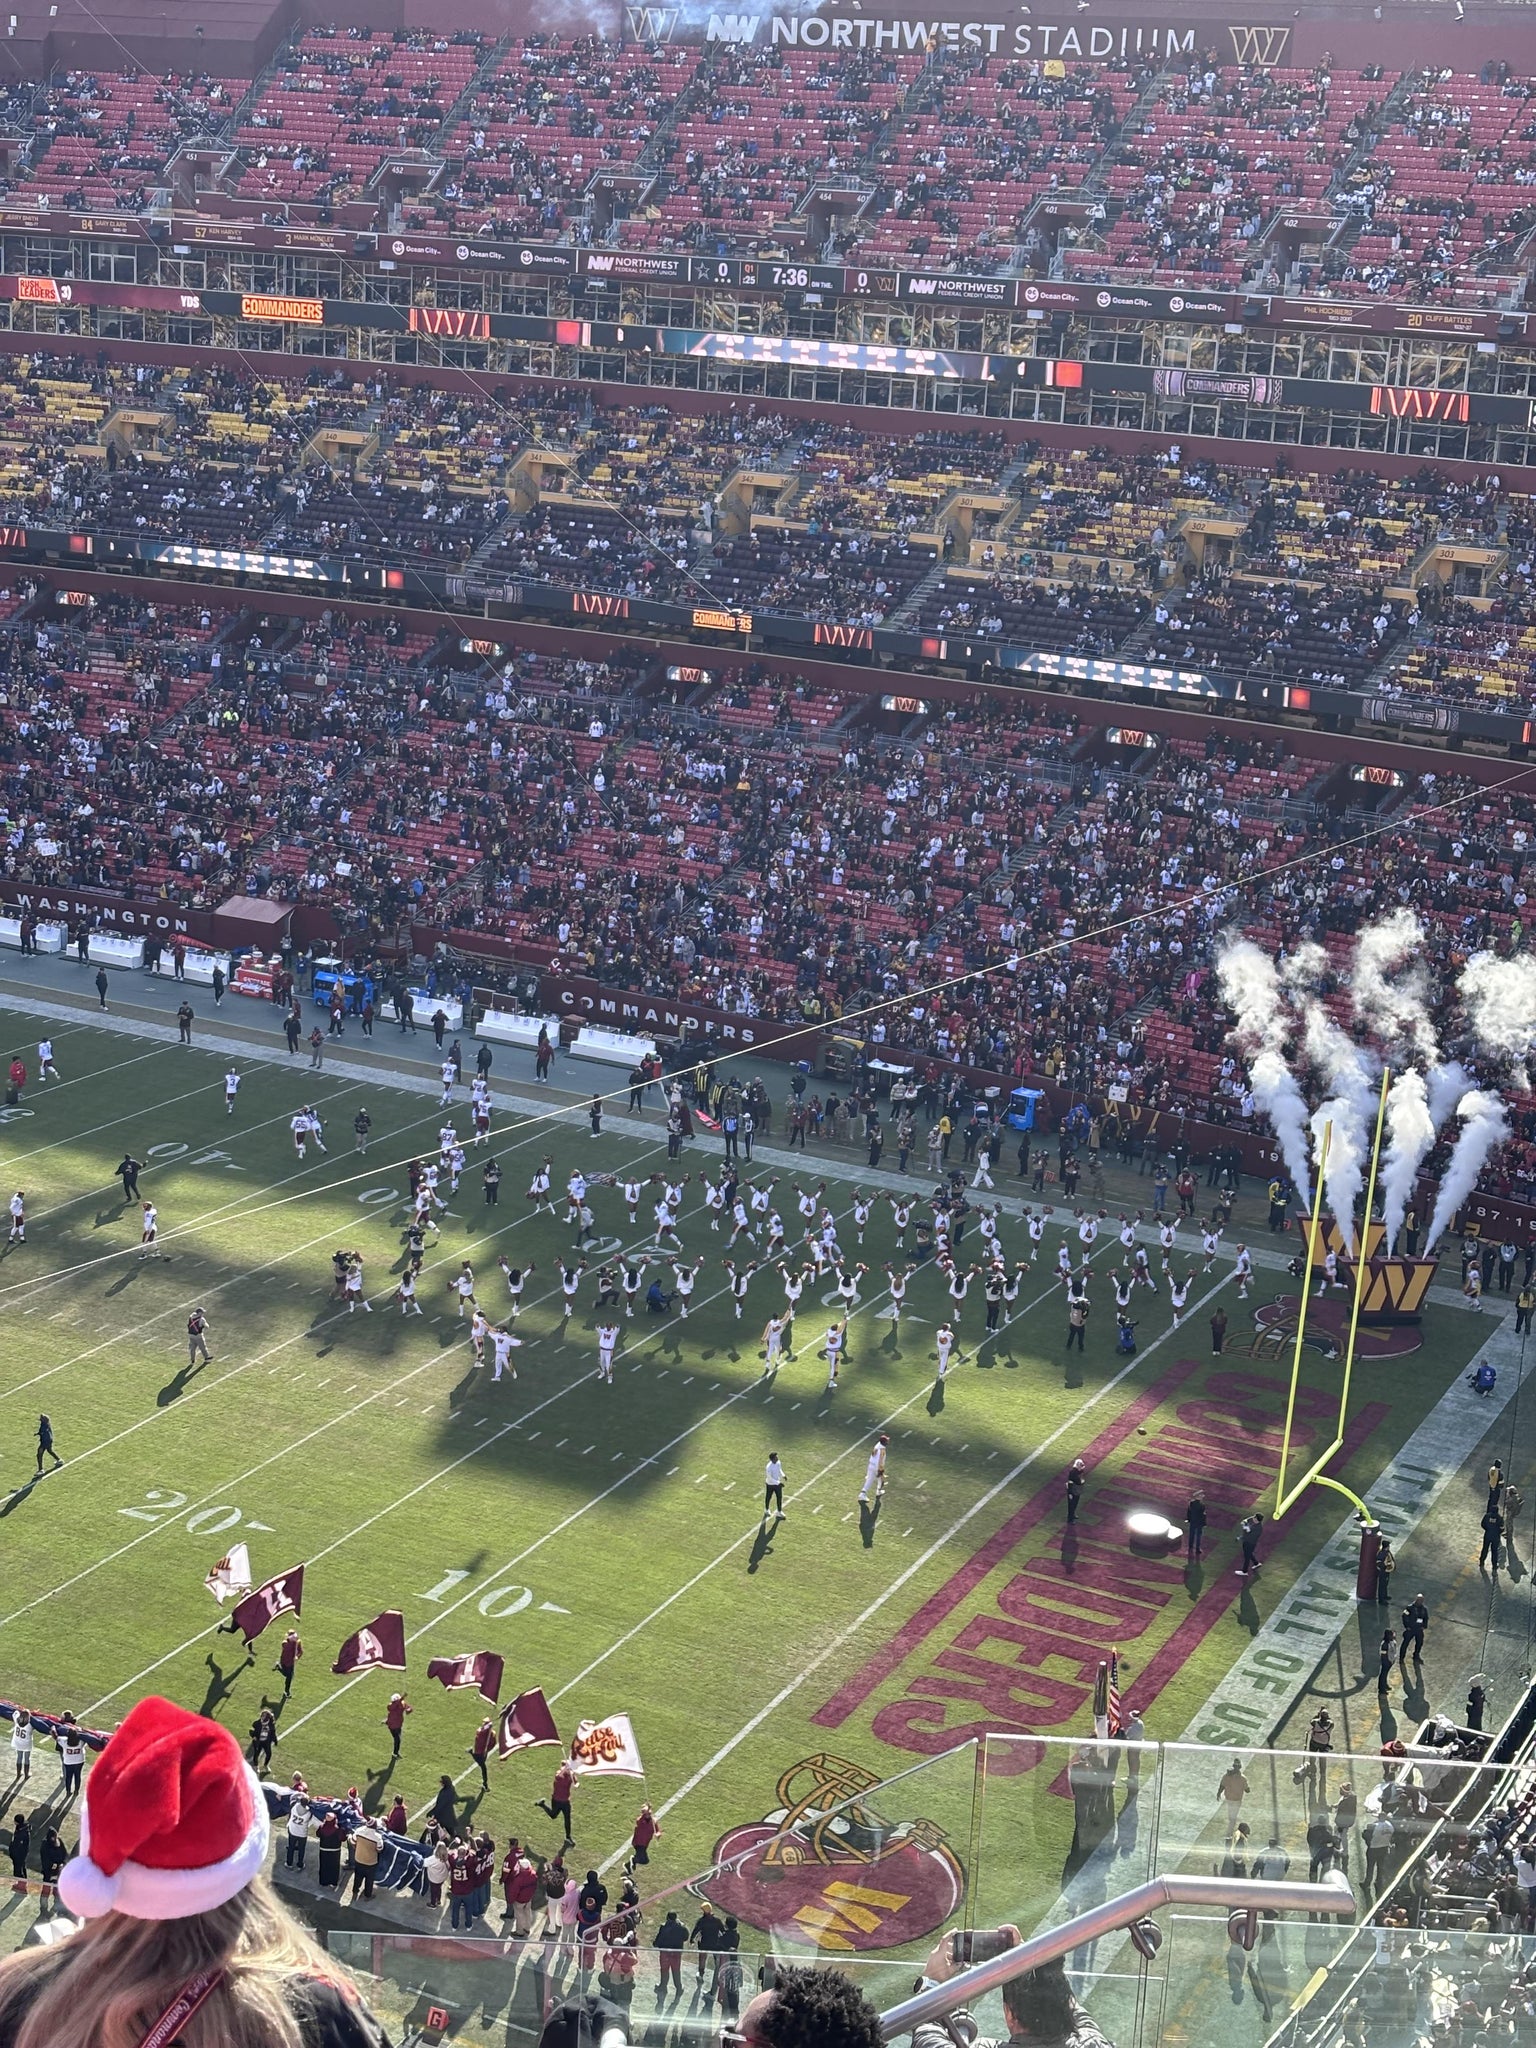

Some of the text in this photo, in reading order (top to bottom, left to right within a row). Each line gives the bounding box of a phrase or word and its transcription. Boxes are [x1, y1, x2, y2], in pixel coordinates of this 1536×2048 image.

[771, 16, 1005, 52] NORTHWEST
[392, 166, 404, 174] 452
[602, 180, 614, 188] 453
[1044, 206, 1058, 215] 401
[81, 219, 93, 230] 84
[1283, 219, 1298, 227] 402
[195, 227, 206, 238] 57
[285, 234, 292, 244] 3
[406, 245, 425, 253] Ocean
[470, 250, 488, 258] Ocean
[534, 255, 552, 263] Ocean
[615, 257, 679, 270] NORTHWEST
[718, 262, 728, 277] 0
[772, 267, 807, 286] 7:36
[858, 272, 868, 287] 0
[20, 279, 40, 289] RUSH
[938, 280, 1006, 294] NORTHWEST
[20, 288, 56, 299] LEADERS
[1040, 292, 1060, 300] Ocean
[180, 295, 200, 308] YDS
[1112, 297, 1133, 305] Ocean
[1185, 302, 1206, 310] Ocean
[242, 298, 323, 320] COMMANDERS
[1408, 314, 1422, 326] 20
[1191, 523, 1206, 531] 302
[1440, 549, 1455, 559] 303
[693, 613, 752, 630] COMMANDRS
[17, 893, 188, 933] WASHNGTON
[561, 991, 755, 1043] COMMANDERS
[118, 1489, 242, 1535] 20
[412, 1569, 533, 1618] 10
[1272, 1580, 1350, 1636] ALL
[1241, 1649, 1304, 1696] OF
[1196, 1701, 1271, 1748] US
[16, 1727, 27, 1739] 86
[293, 1815, 304, 1825] 22
[453, 1868, 467, 1881] 21
[430, 2011, 443, 2027] G
